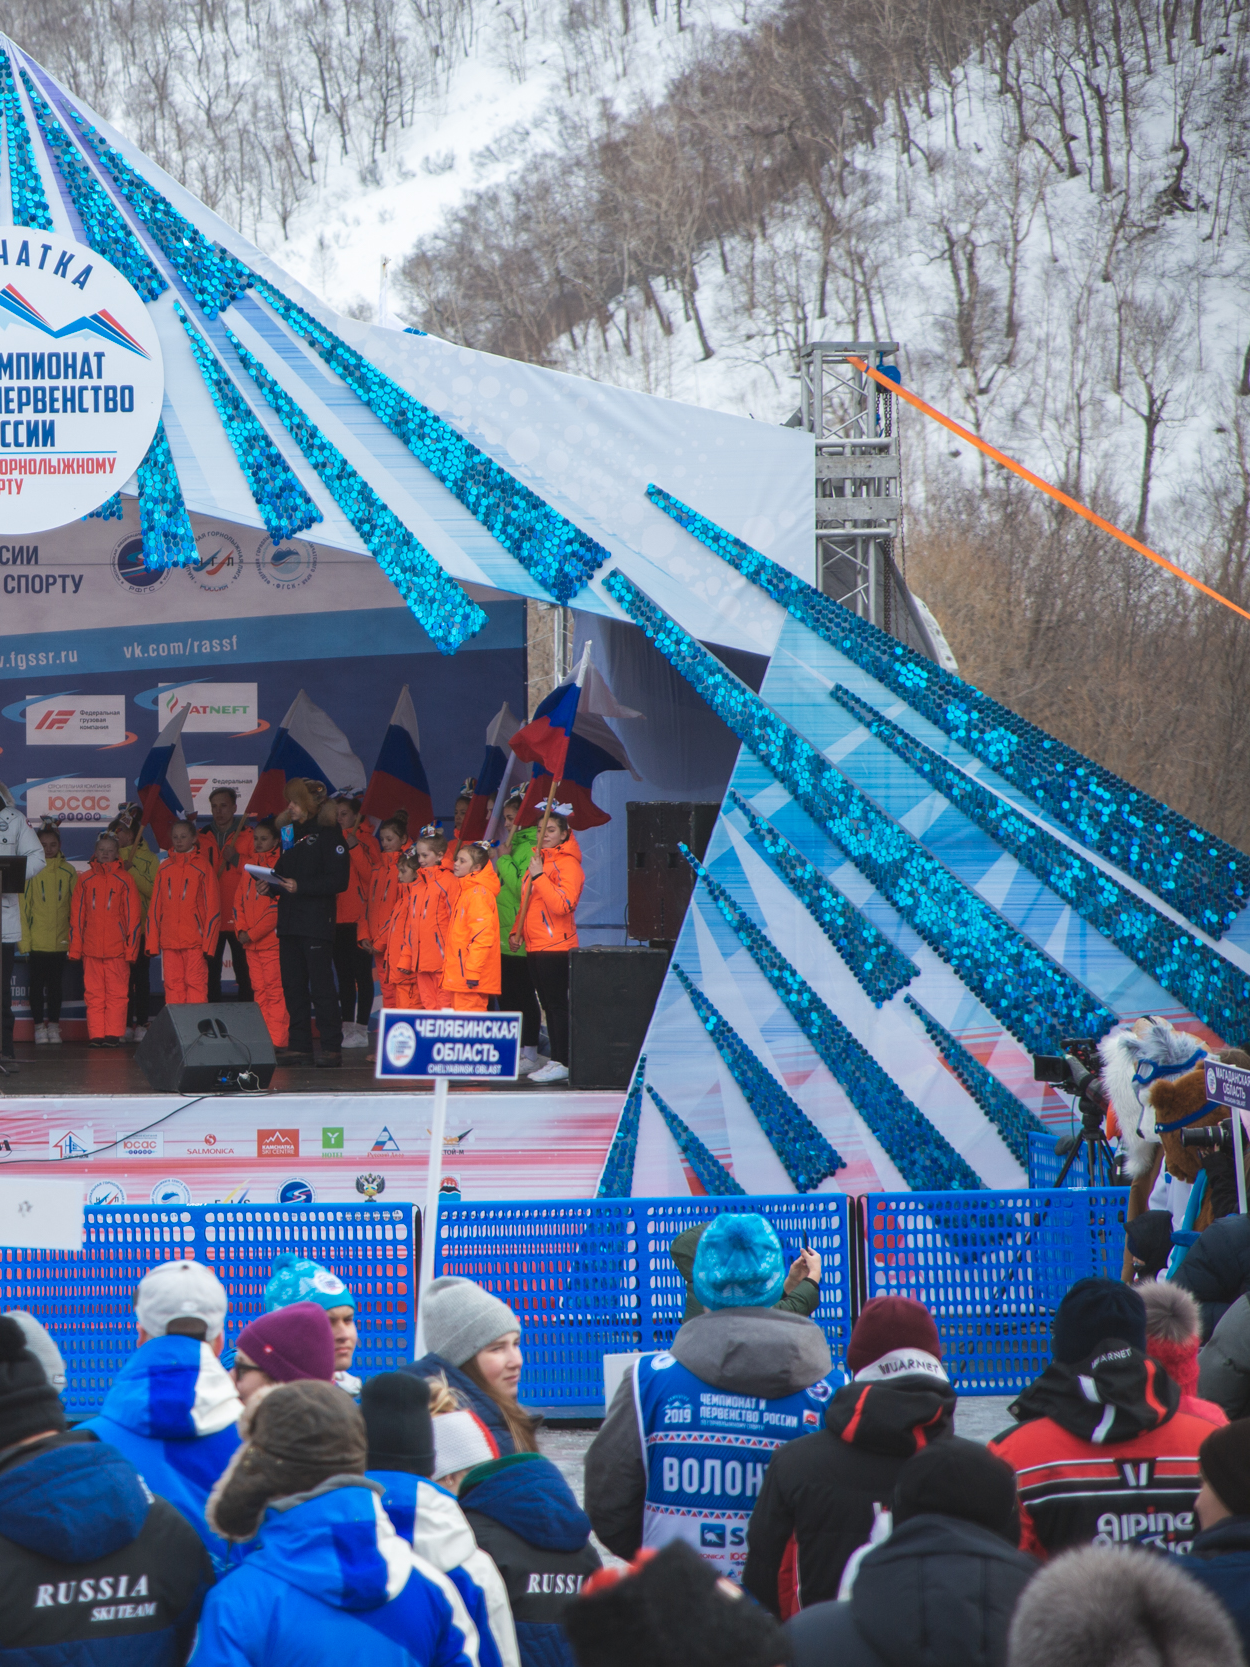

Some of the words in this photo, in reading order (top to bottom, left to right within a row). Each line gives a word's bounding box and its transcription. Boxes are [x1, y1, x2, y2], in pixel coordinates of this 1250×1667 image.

[3, 574, 84, 594] СПОРТУ
[123, 635, 238, 658] vk.com/rassf
[415, 1018, 519, 1039] ЧЕЛЯБИНСКАЯ
[432, 1042, 500, 1062] ОБЛАСТЬ
[1222, 1082, 1246, 1099] ОБЛАСТЬ
[878, 1358, 939, 1375] VUARNET
[700, 1393, 756, 1409] ЧЕМПИОНАТ
[759, 1399, 767, 1410] И
[665, 1408, 692, 1424] 2019
[700, 1406, 759, 1423] ПЕРВЕНСТВО
[763, 1412, 798, 1428] РОССИИ
[663, 1457, 769, 1497] ВОЛОН
[1096, 1506, 1194, 1541] Alpine
[34, 1574, 149, 1608] RUSSIA
[527, 1573, 592, 1594] RUSSI
[90, 1606, 116, 1621] SKI
[117, 1602, 157, 1618] TEAM
